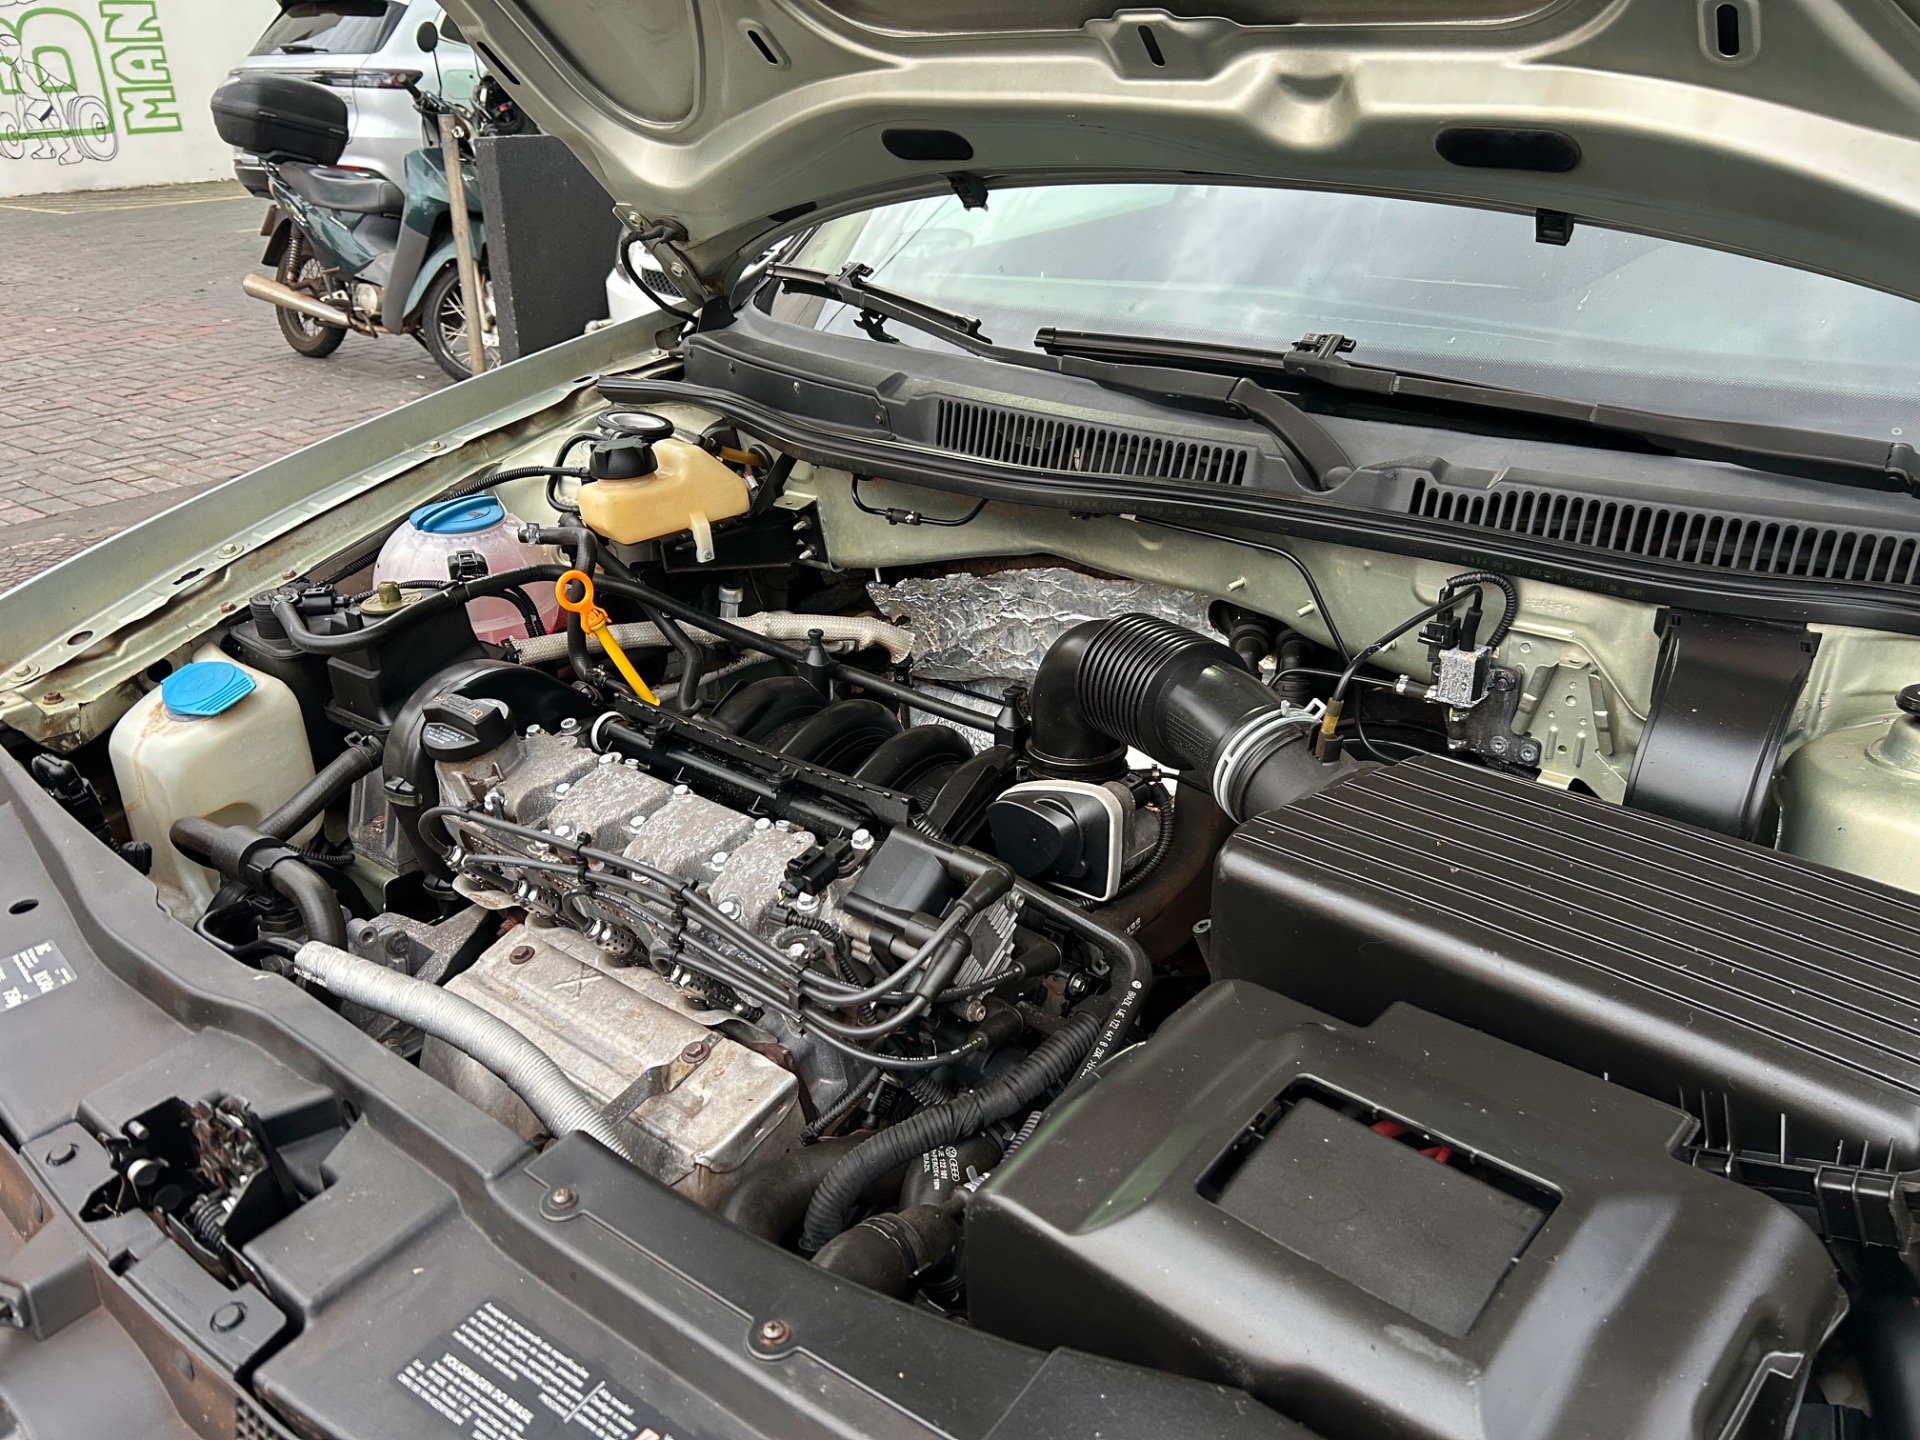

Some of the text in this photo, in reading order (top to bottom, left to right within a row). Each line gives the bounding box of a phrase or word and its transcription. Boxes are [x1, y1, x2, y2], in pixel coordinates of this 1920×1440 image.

[98, 0, 182, 135] MAN
[442, 1351, 535, 1426] VOLKSWAGEN DO BRASIL
